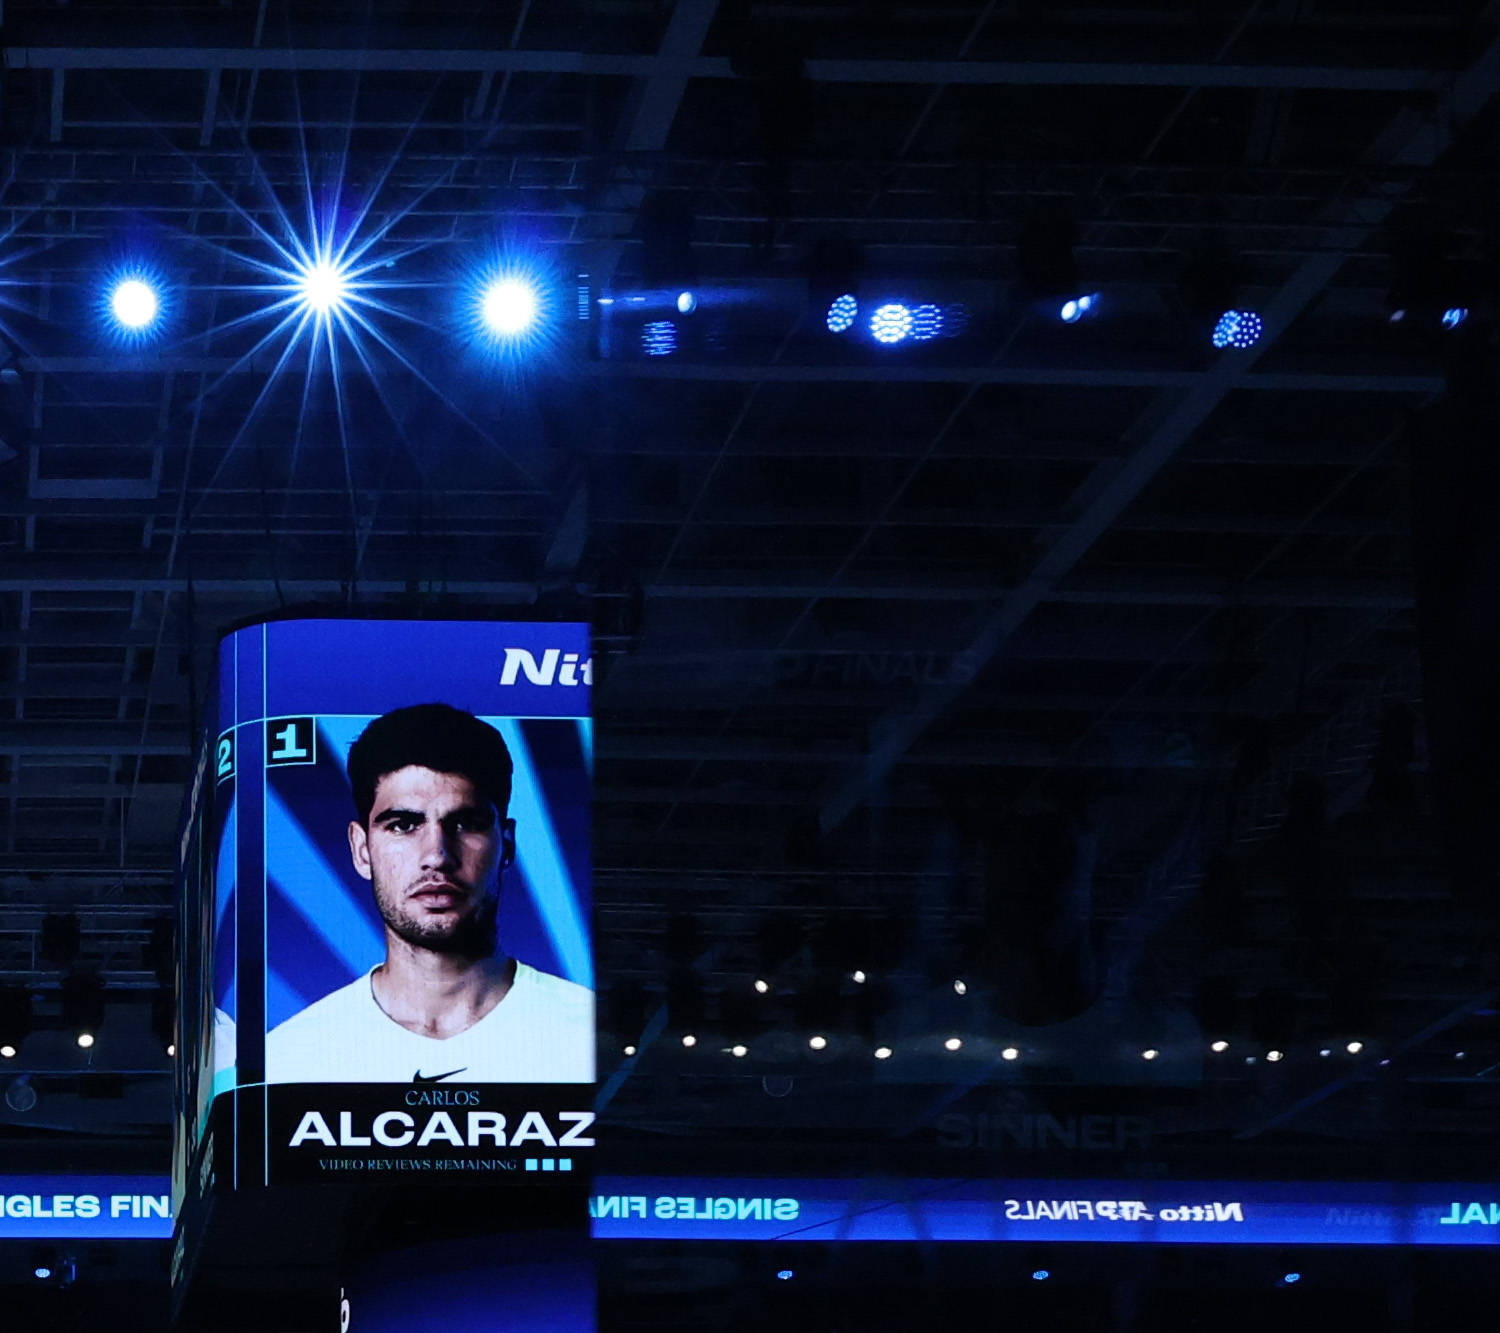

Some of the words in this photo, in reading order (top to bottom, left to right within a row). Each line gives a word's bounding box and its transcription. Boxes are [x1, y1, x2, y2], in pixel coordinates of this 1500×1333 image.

[501, 648, 593, 686] Nit
[272, 724, 307, 759] 1
[405, 1090, 480, 1106] CARLOS
[289, 1111, 596, 1147] ALCARAZ
[318, 1159, 364, 1171] VIDEO
[367, 1159, 431, 1171] REVIEWS
[435, 1159, 517, 1171] REMAINING
[110, 1195, 171, 1218] FIN
